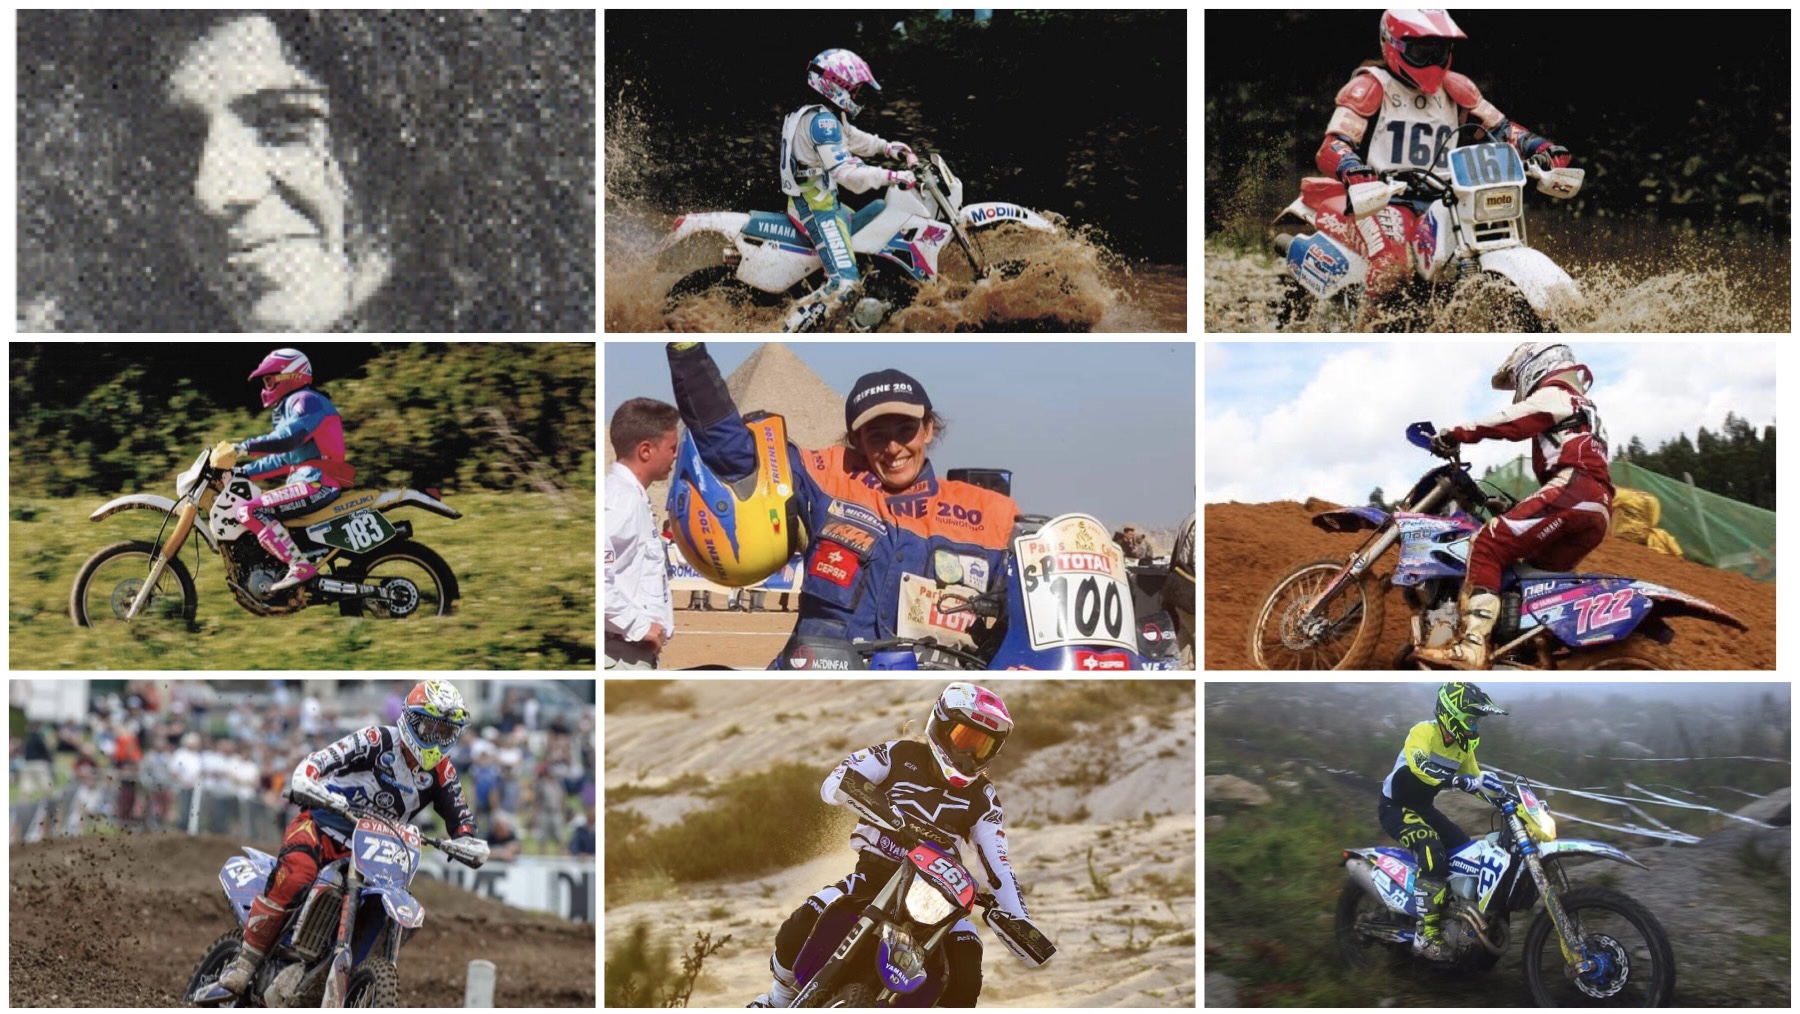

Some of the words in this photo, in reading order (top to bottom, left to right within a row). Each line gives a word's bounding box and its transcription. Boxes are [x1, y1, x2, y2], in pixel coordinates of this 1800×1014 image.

[1459, 142, 1516, 186] 167
[1486, 194, 1512, 206] moto
[758, 221, 796, 239] YAMAHA
[820, 219, 853, 269] SINISALO
[853, 384, 891, 403] TRIFENE
[892, 383, 913, 392] 200
[764, 426, 775, 442] 200
[768, 445, 780, 485] TRIFENE
[334, 495, 375, 513] SUZUKI
[937, 501, 983, 526] 200
[698, 509, 711, 534] 200
[845, 507, 887, 531] MICHELIN
[341, 513, 385, 551] 183
[850, 542, 868, 552] TEAM
[816, 561, 848, 580] CEPSA
[1060, 554, 1111, 572] TOTAL
[1050, 575, 1123, 640] 100
[1573, 588, 1634, 635] 722
[928, 857, 970, 896] 561
[1451, 857, 1480, 875] jetmar
[885, 962, 910, 986] YAMAHA
